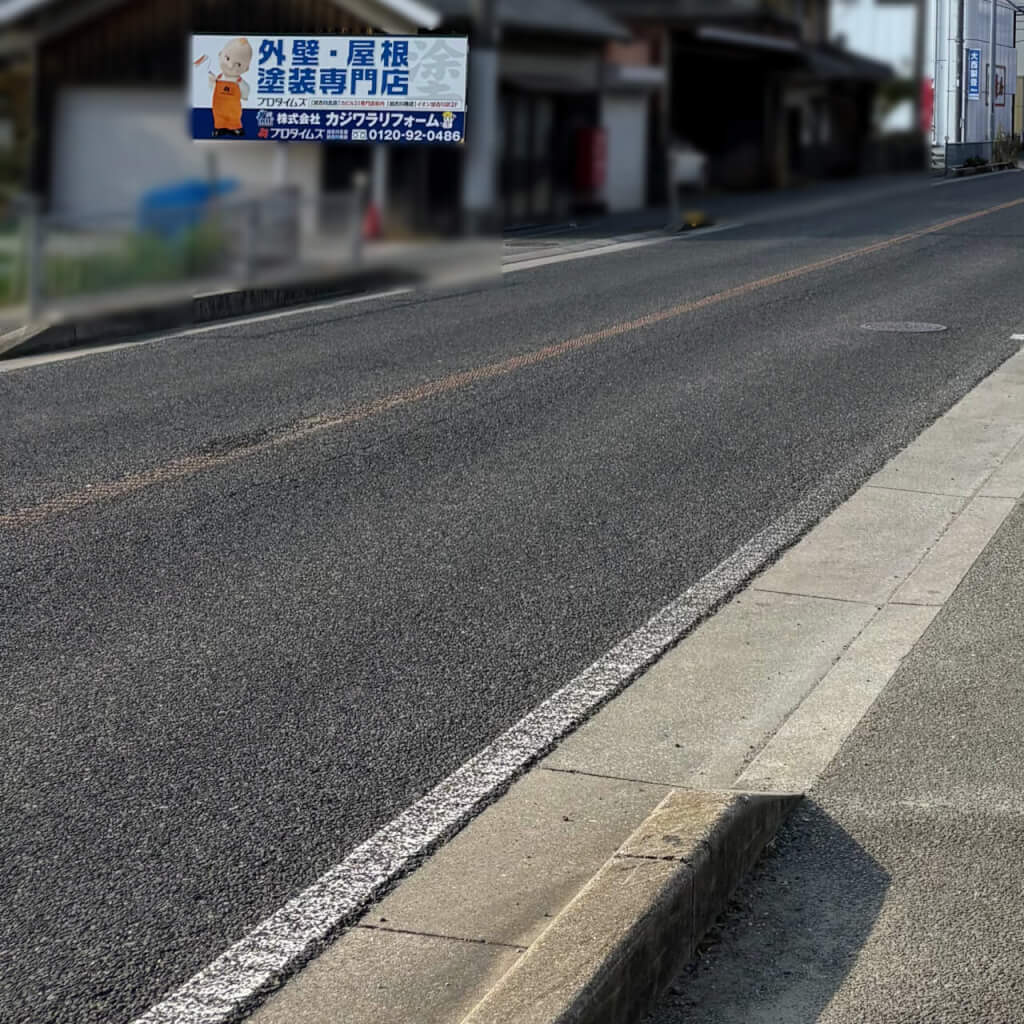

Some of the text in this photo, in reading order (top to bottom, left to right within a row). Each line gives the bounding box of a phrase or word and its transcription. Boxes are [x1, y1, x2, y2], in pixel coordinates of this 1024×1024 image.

[258, 39, 409, 67] 外壁・屋根
[257, 68, 409, 96] 塗装専門店
[257, 97, 307, 107] プロタイムズ
[276, 111, 439, 127] 株式会社 カジワラリフォーム
[270, 128, 324, 140] プロタイムズ
[368, 128, 461, 141] 0120-92-0486
